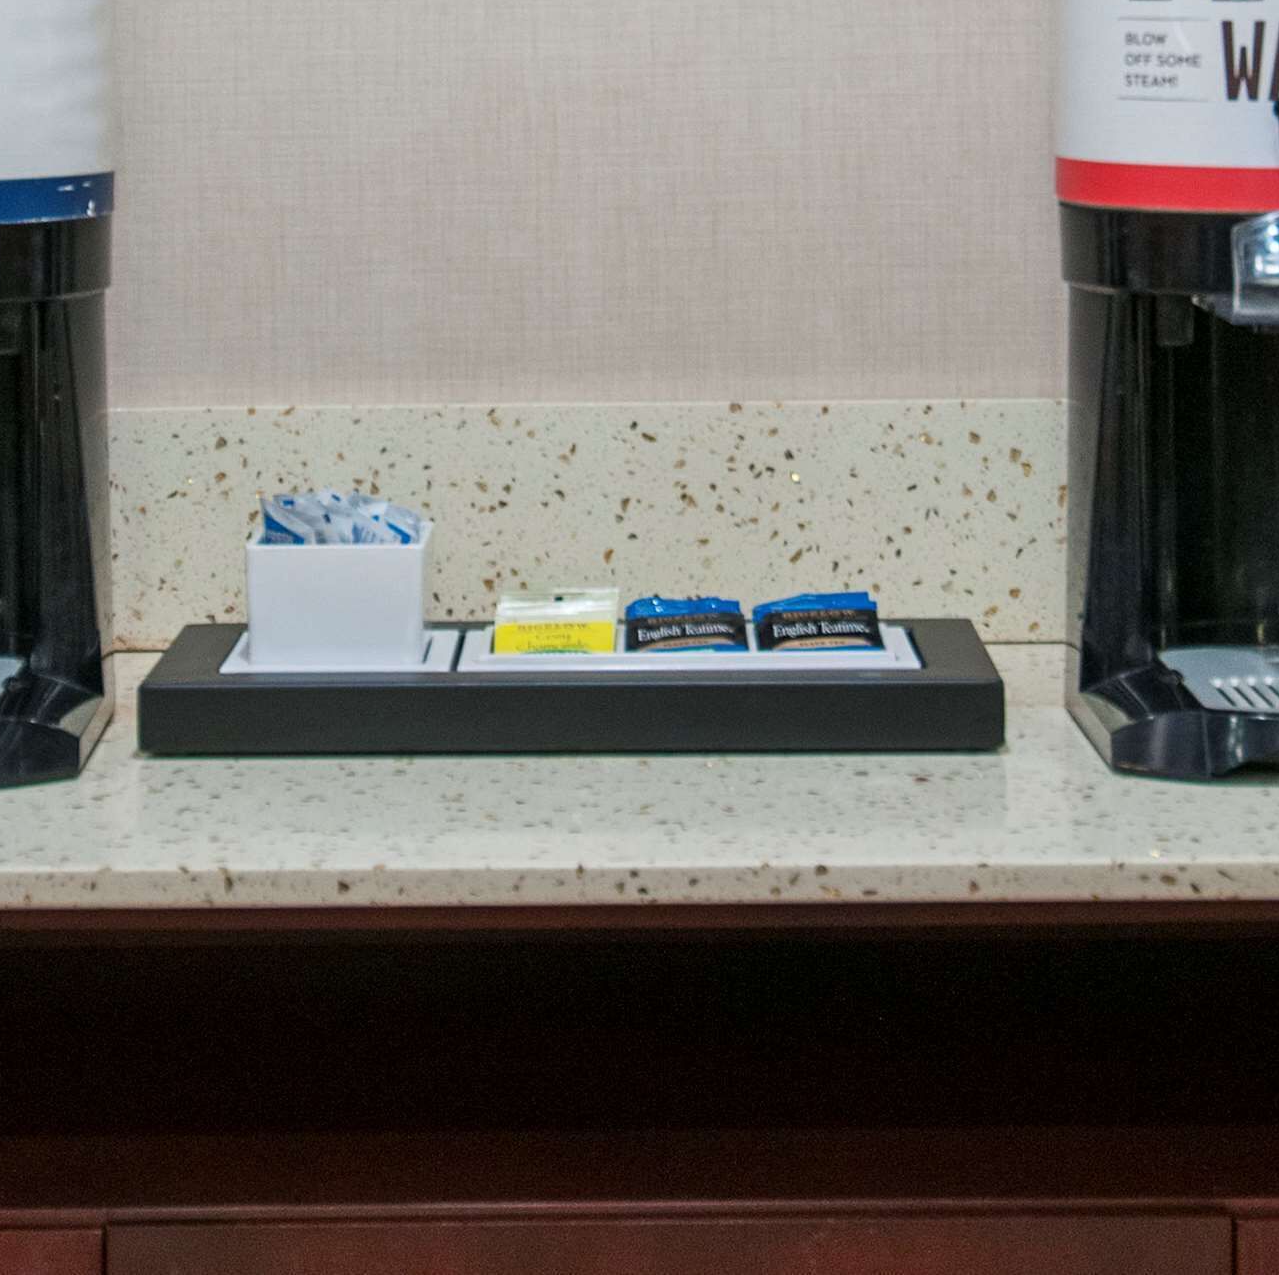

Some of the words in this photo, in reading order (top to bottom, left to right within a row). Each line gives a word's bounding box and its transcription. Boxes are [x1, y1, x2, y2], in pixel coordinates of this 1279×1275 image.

[1125, 32, 1166, 46] BLOW
[1125, 54, 1151, 67] OFF
[1157, 54, 1201, 68] SOME
[637, 624, 681, 642] English
[772, 623, 817, 638] English
